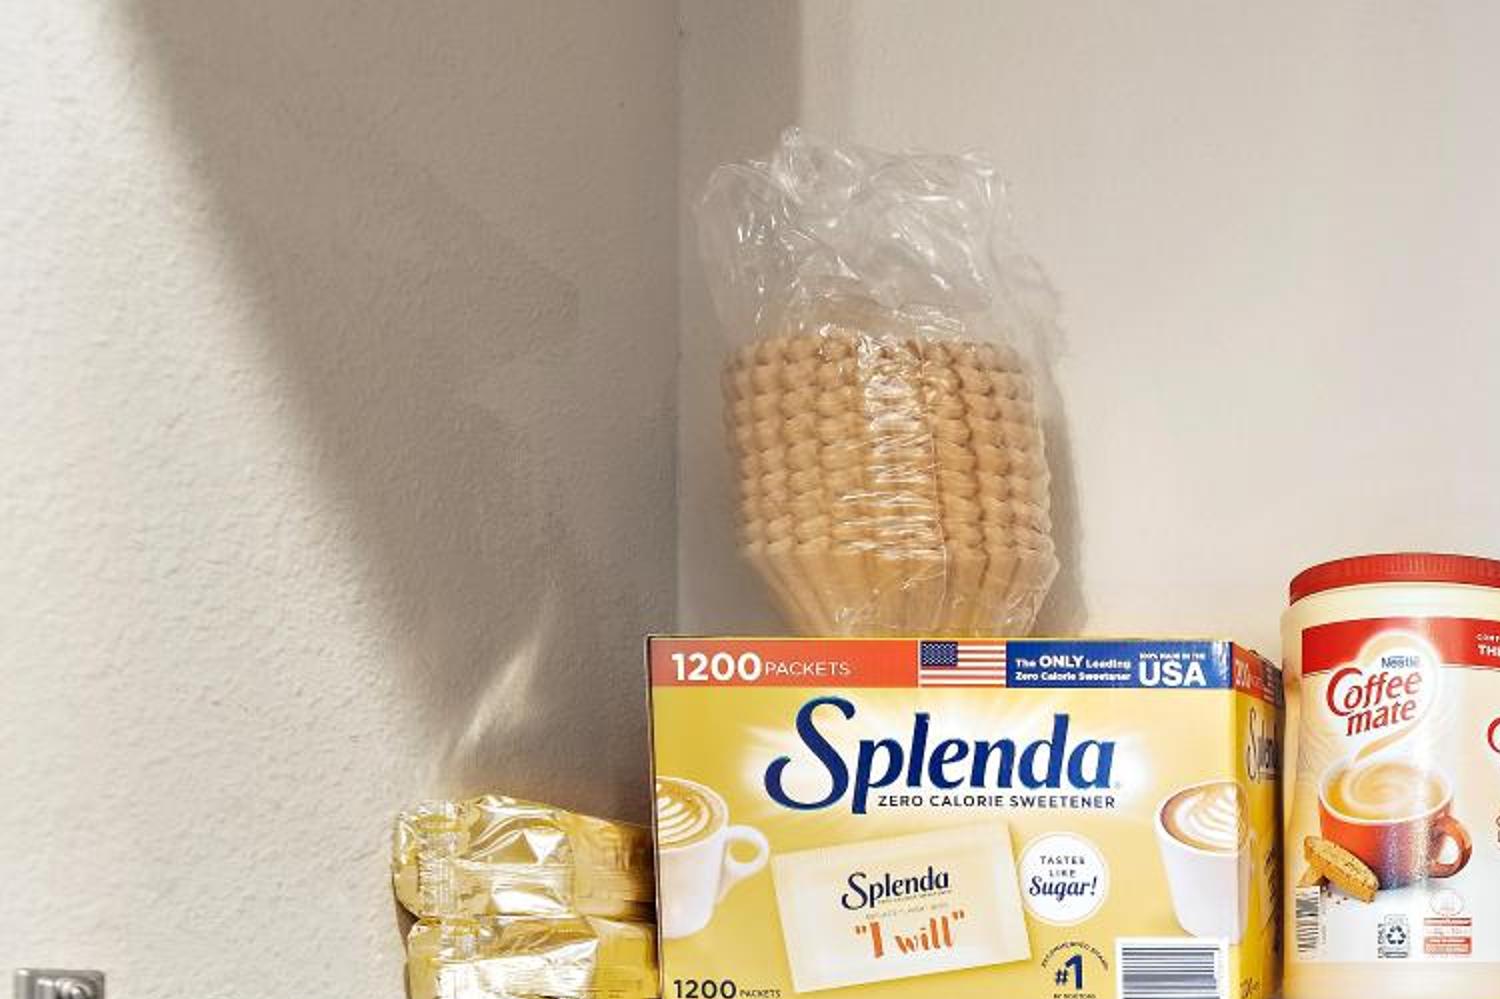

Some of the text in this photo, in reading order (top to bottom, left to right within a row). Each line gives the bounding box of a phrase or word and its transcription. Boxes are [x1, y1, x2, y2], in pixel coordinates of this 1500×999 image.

[671, 652, 850, 681] 1200 PACKETS
[1015, 655, 1131, 671] The ONLY Leading
[1015, 671, 1131, 682] Zero Calorie Sweetener
[1138, 661, 1207, 687] USA
[1326, 666, 1423, 717] Coffee
[1346, 697, 1416, 737] mate
[764, 695, 1116, 815] Splenda
[878, 795, 1116, 809] ZERO CALORIE SWEETENER
[1040, 855, 1086, 866] TASTES
[1049, 869, 1076, 878] LIKE
[841, 865, 950, 911] Splenda
[1029, 875, 1098, 903] Sugar!
[1055, 954, 1083, 991] #1
[674, 979, 781, 999] 1200 PACKETS
